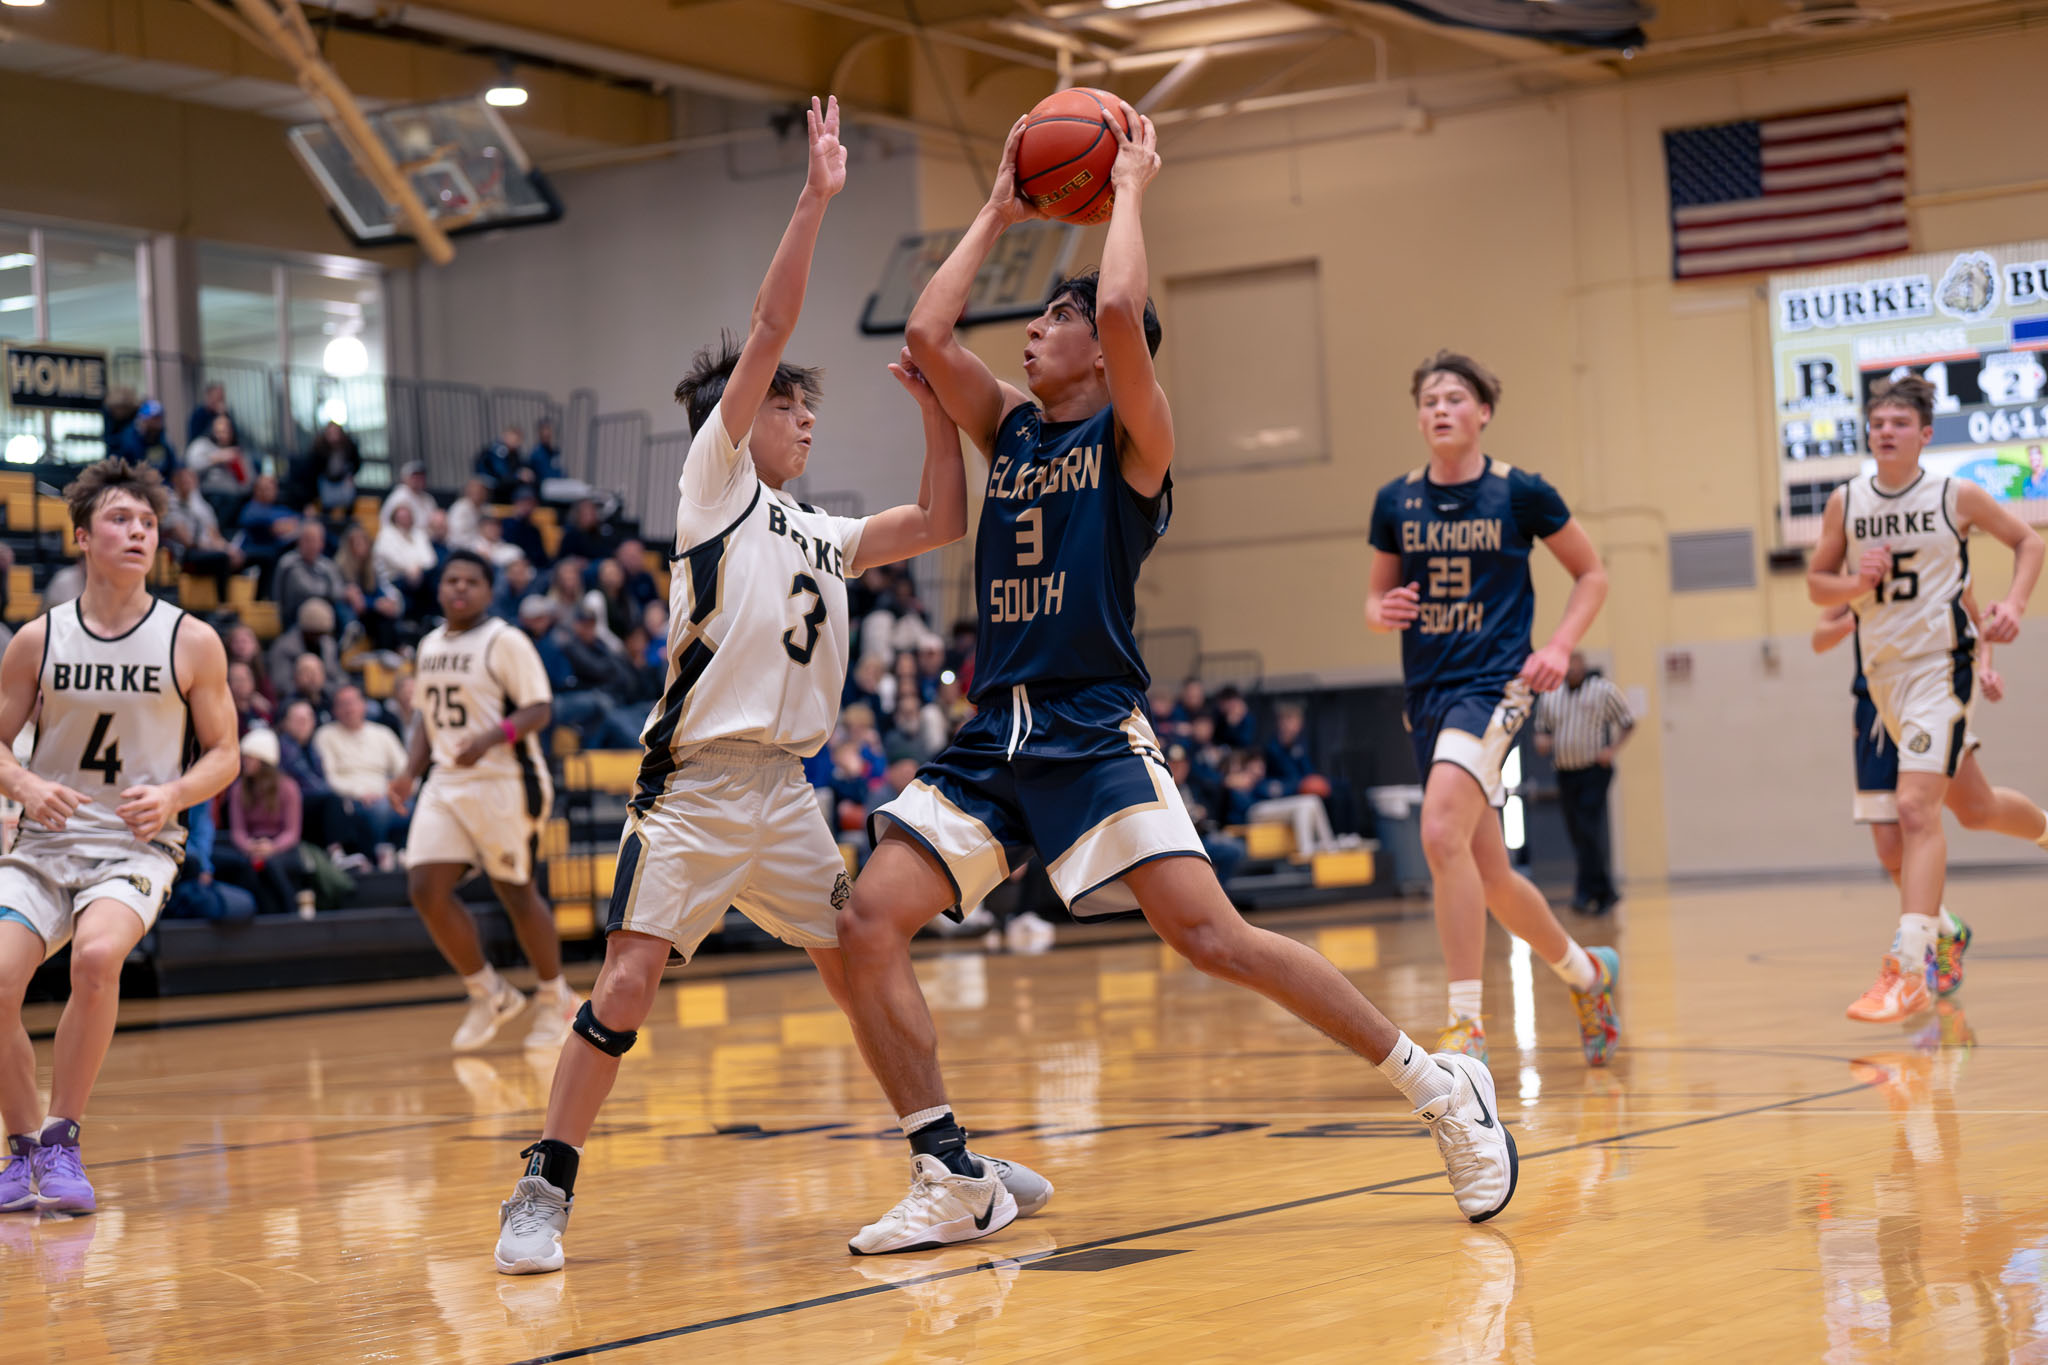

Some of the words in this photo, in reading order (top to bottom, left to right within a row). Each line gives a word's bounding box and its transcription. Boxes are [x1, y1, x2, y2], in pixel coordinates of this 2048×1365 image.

[1788, 282, 1927, 322] BURKE
[11, 354, 104, 399] HOME
[1015, 507, 1043, 567] 3
[1402, 518, 1501, 553] ELKHORN
[1855, 511, 1936, 539] BURKE
[990, 571, 1066, 623] SOUTH
[1427, 556, 1471, 598] 23
[779, 570, 827, 668] 3
[1420, 602, 1484, 635] SOUTH
[54, 663, 162, 694] BURKE
[426, 685, 467, 728] 25
[79, 711, 123, 786] 4
